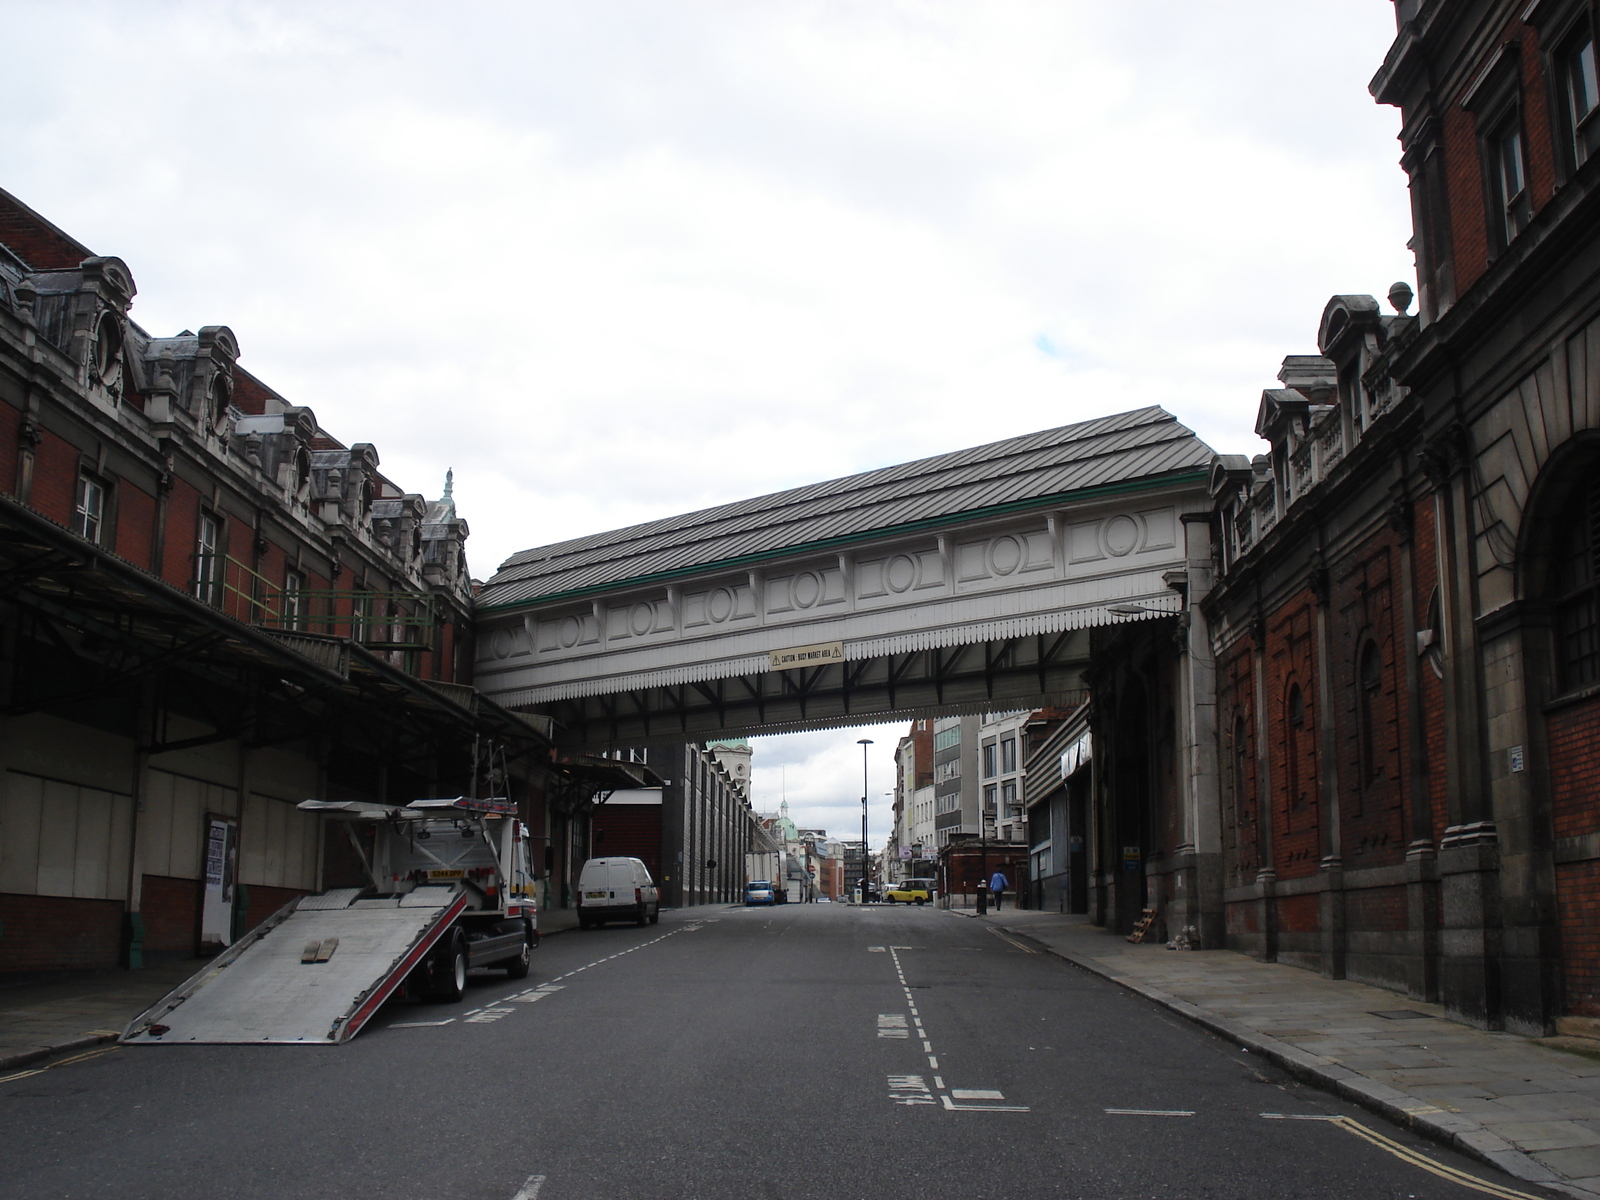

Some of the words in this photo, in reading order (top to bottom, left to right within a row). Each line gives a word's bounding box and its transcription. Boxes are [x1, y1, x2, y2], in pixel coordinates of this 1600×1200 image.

[782, 655, 795, 663] CAUTION
[798, 653, 807, 661] BUSY
[808, 651, 821, 659] MARKET
